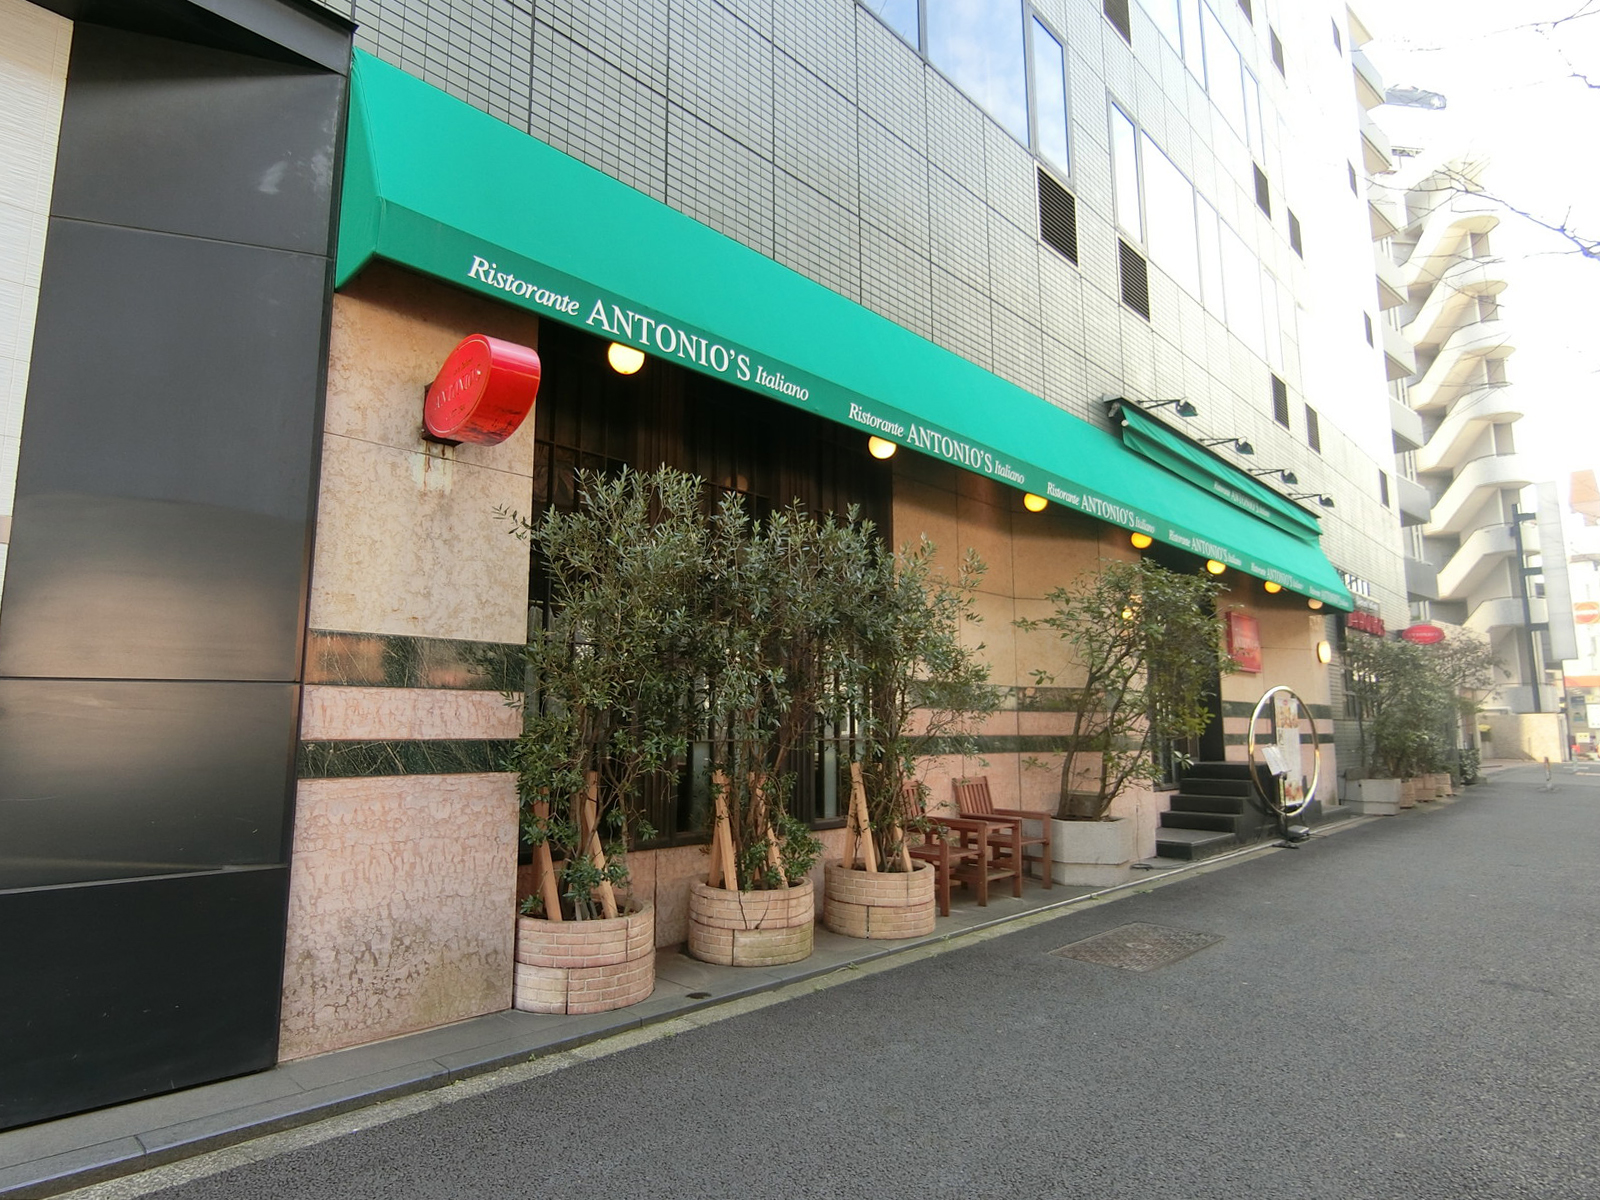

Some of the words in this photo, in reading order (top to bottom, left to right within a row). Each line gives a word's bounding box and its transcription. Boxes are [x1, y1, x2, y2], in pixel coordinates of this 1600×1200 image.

[467, 254, 580, 316] Ristorante
[586, 299, 751, 381] ANTONIO'S
[755, 365, 809, 401] Italiano
[848, 402, 904, 437] Ristorante
[906, 423, 993, 473] ANTONIO'S
[994, 460, 1025, 485] Italiano
[1046, 481, 1081, 506] Ristorante
[1081, 494, 1135, 528] ANTONIO'S
